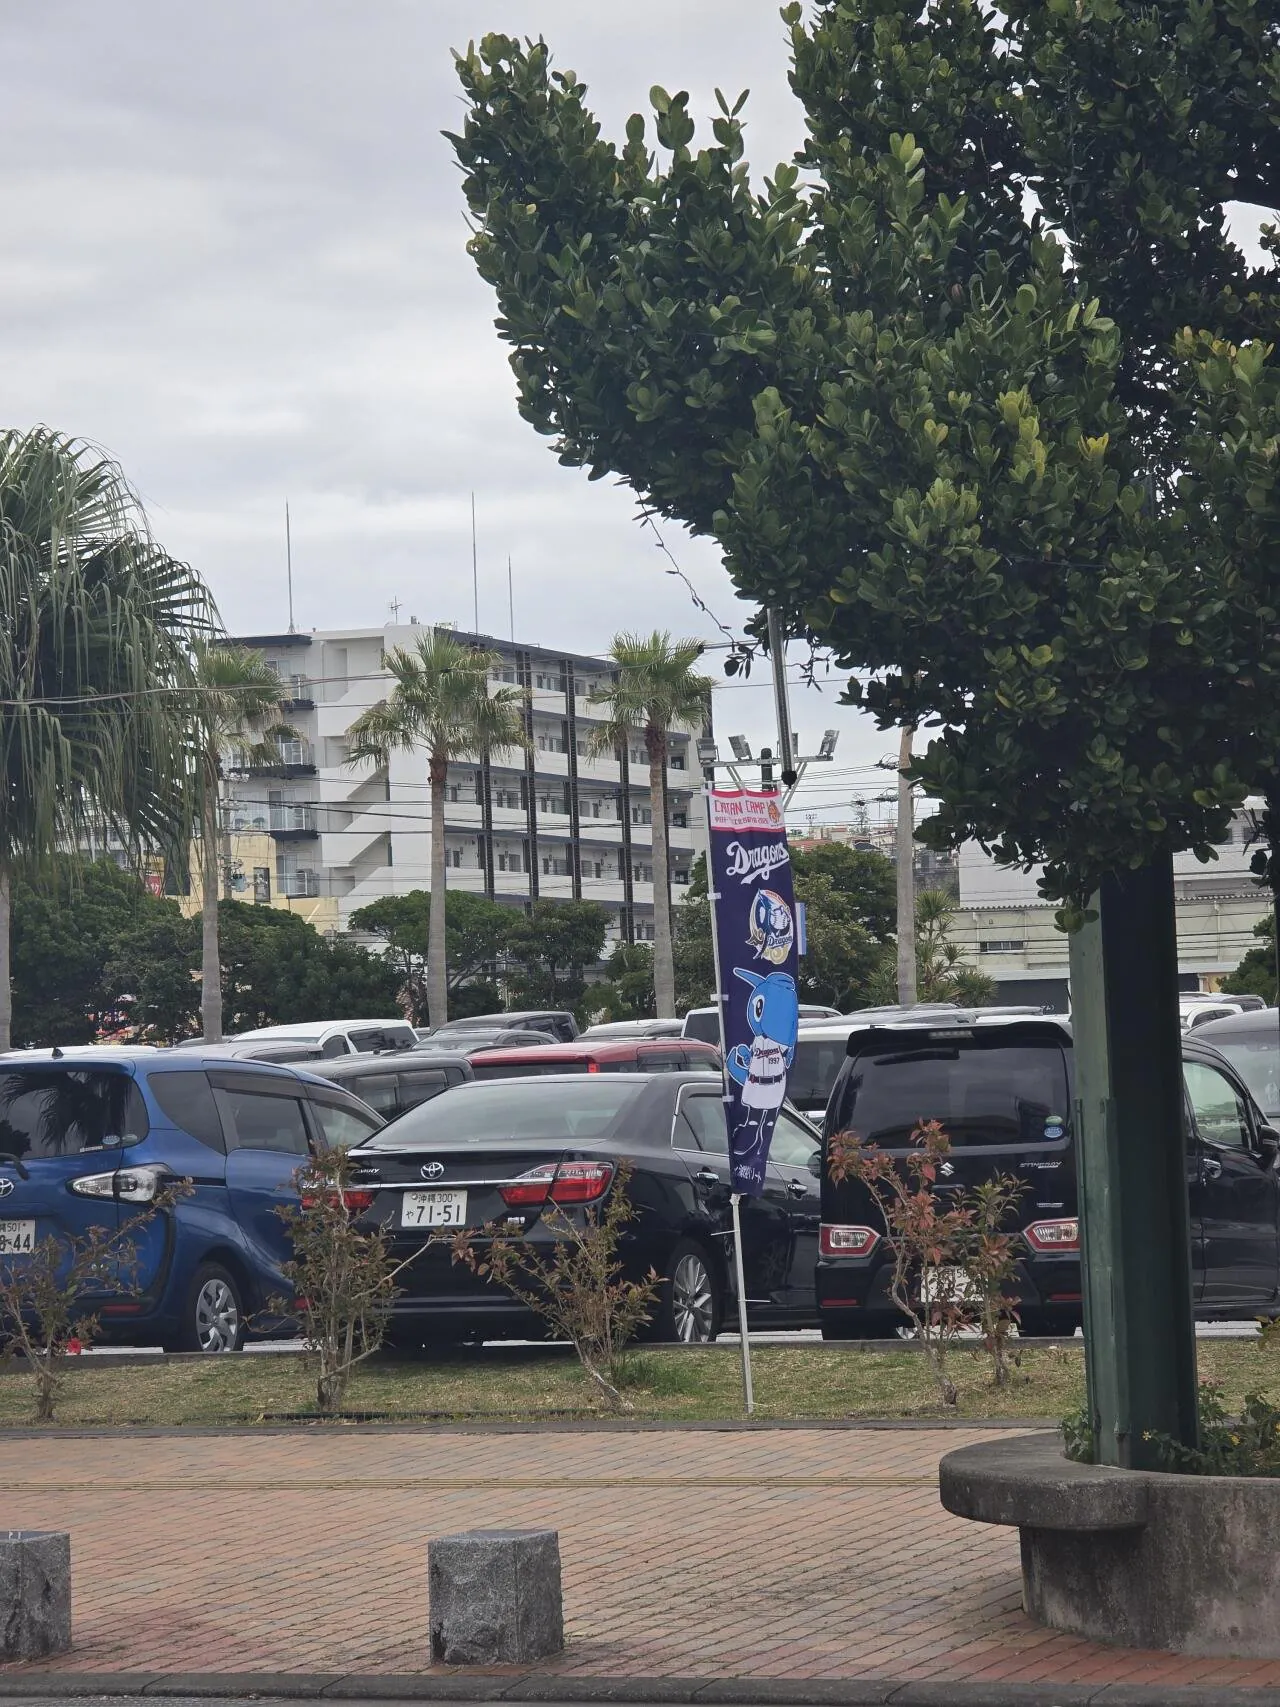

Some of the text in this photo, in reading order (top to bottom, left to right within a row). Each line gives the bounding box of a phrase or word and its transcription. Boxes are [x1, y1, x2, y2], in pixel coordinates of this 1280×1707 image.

[745, 800, 766, 815] CAMP
[726, 841, 790, 884] Dragons
[754, 1048, 779, 1059] Dragons
[417, 1204, 460, 1223] 71-51
